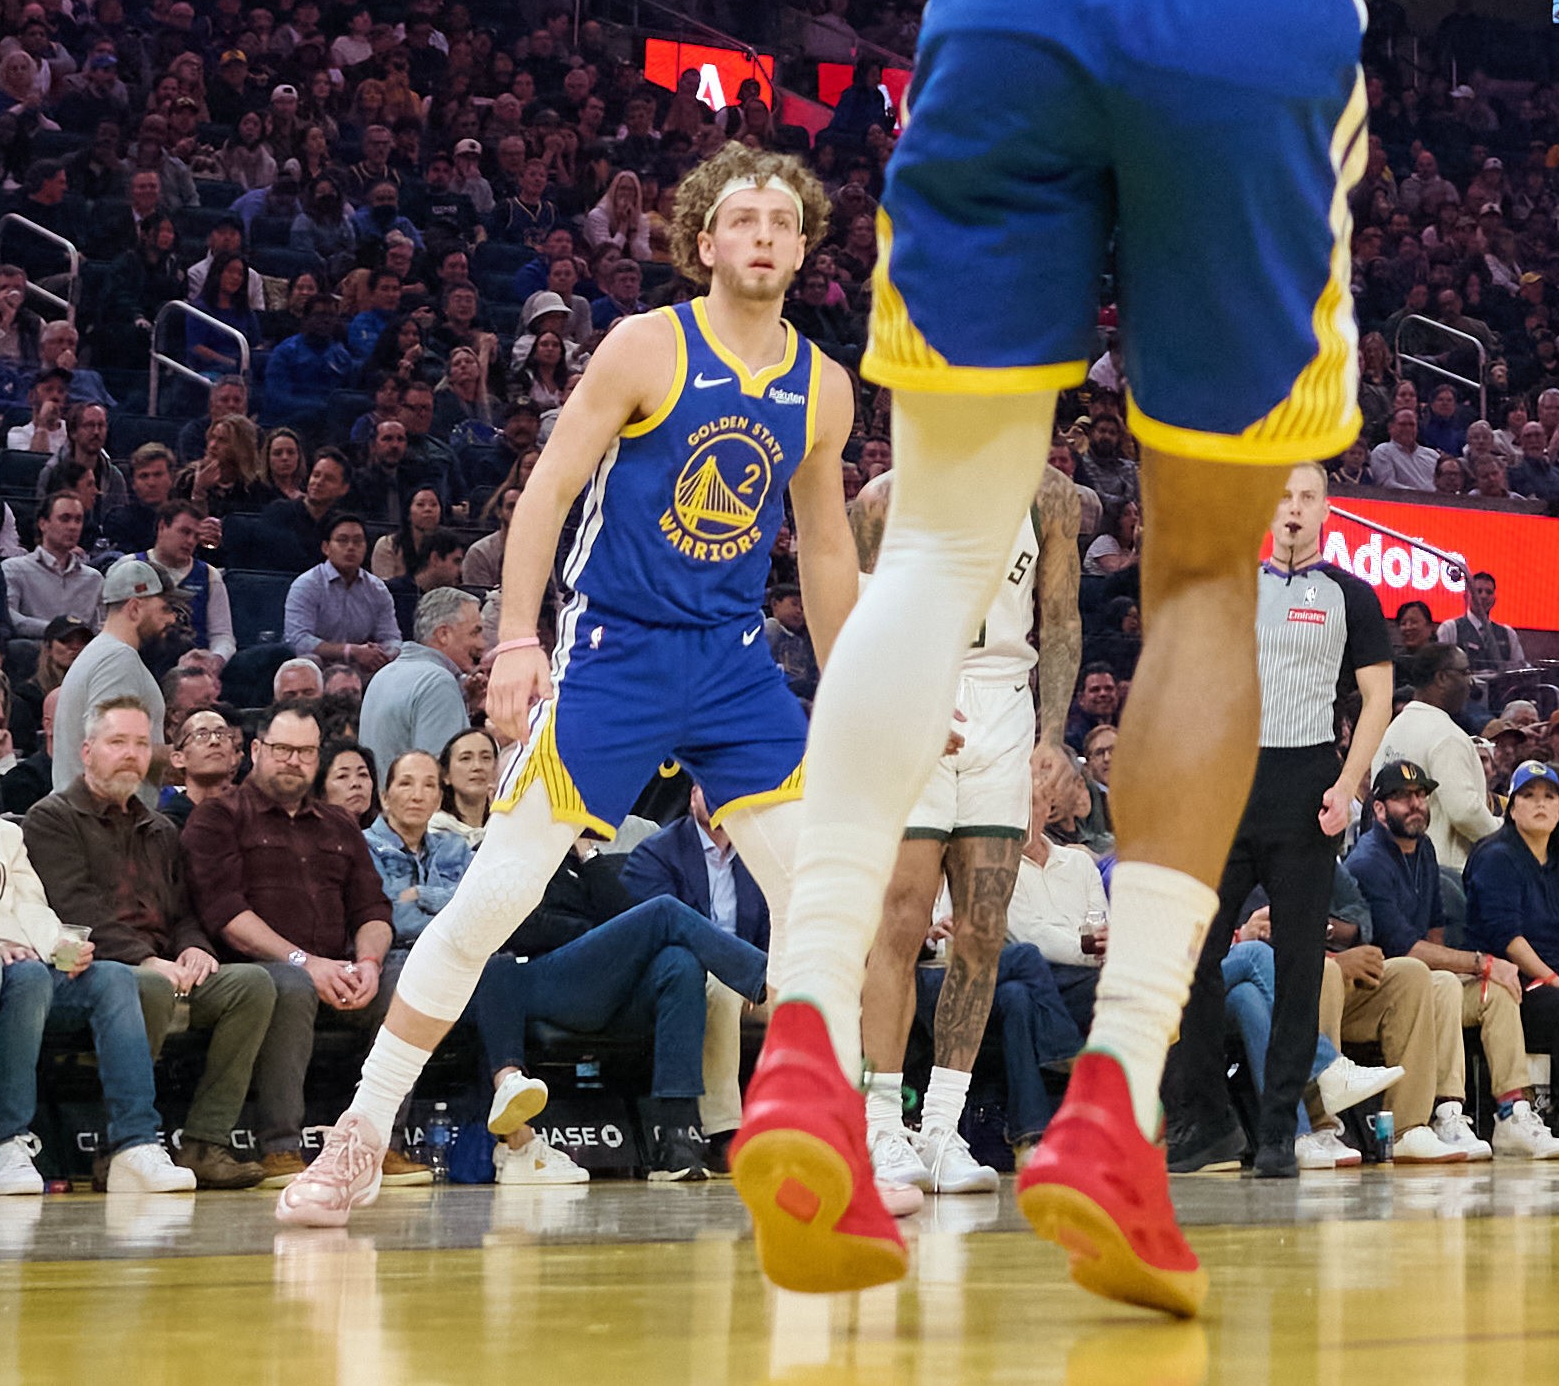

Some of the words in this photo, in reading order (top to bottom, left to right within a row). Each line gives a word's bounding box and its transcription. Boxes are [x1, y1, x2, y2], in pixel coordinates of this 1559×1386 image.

[688, 415, 749, 446] GOLDEN
[752, 423, 784, 464] STATE
[737, 463, 761, 494] 2
[658, 507, 762, 562] WARRIORS
[1289, 610, 1325, 622] Emirates
